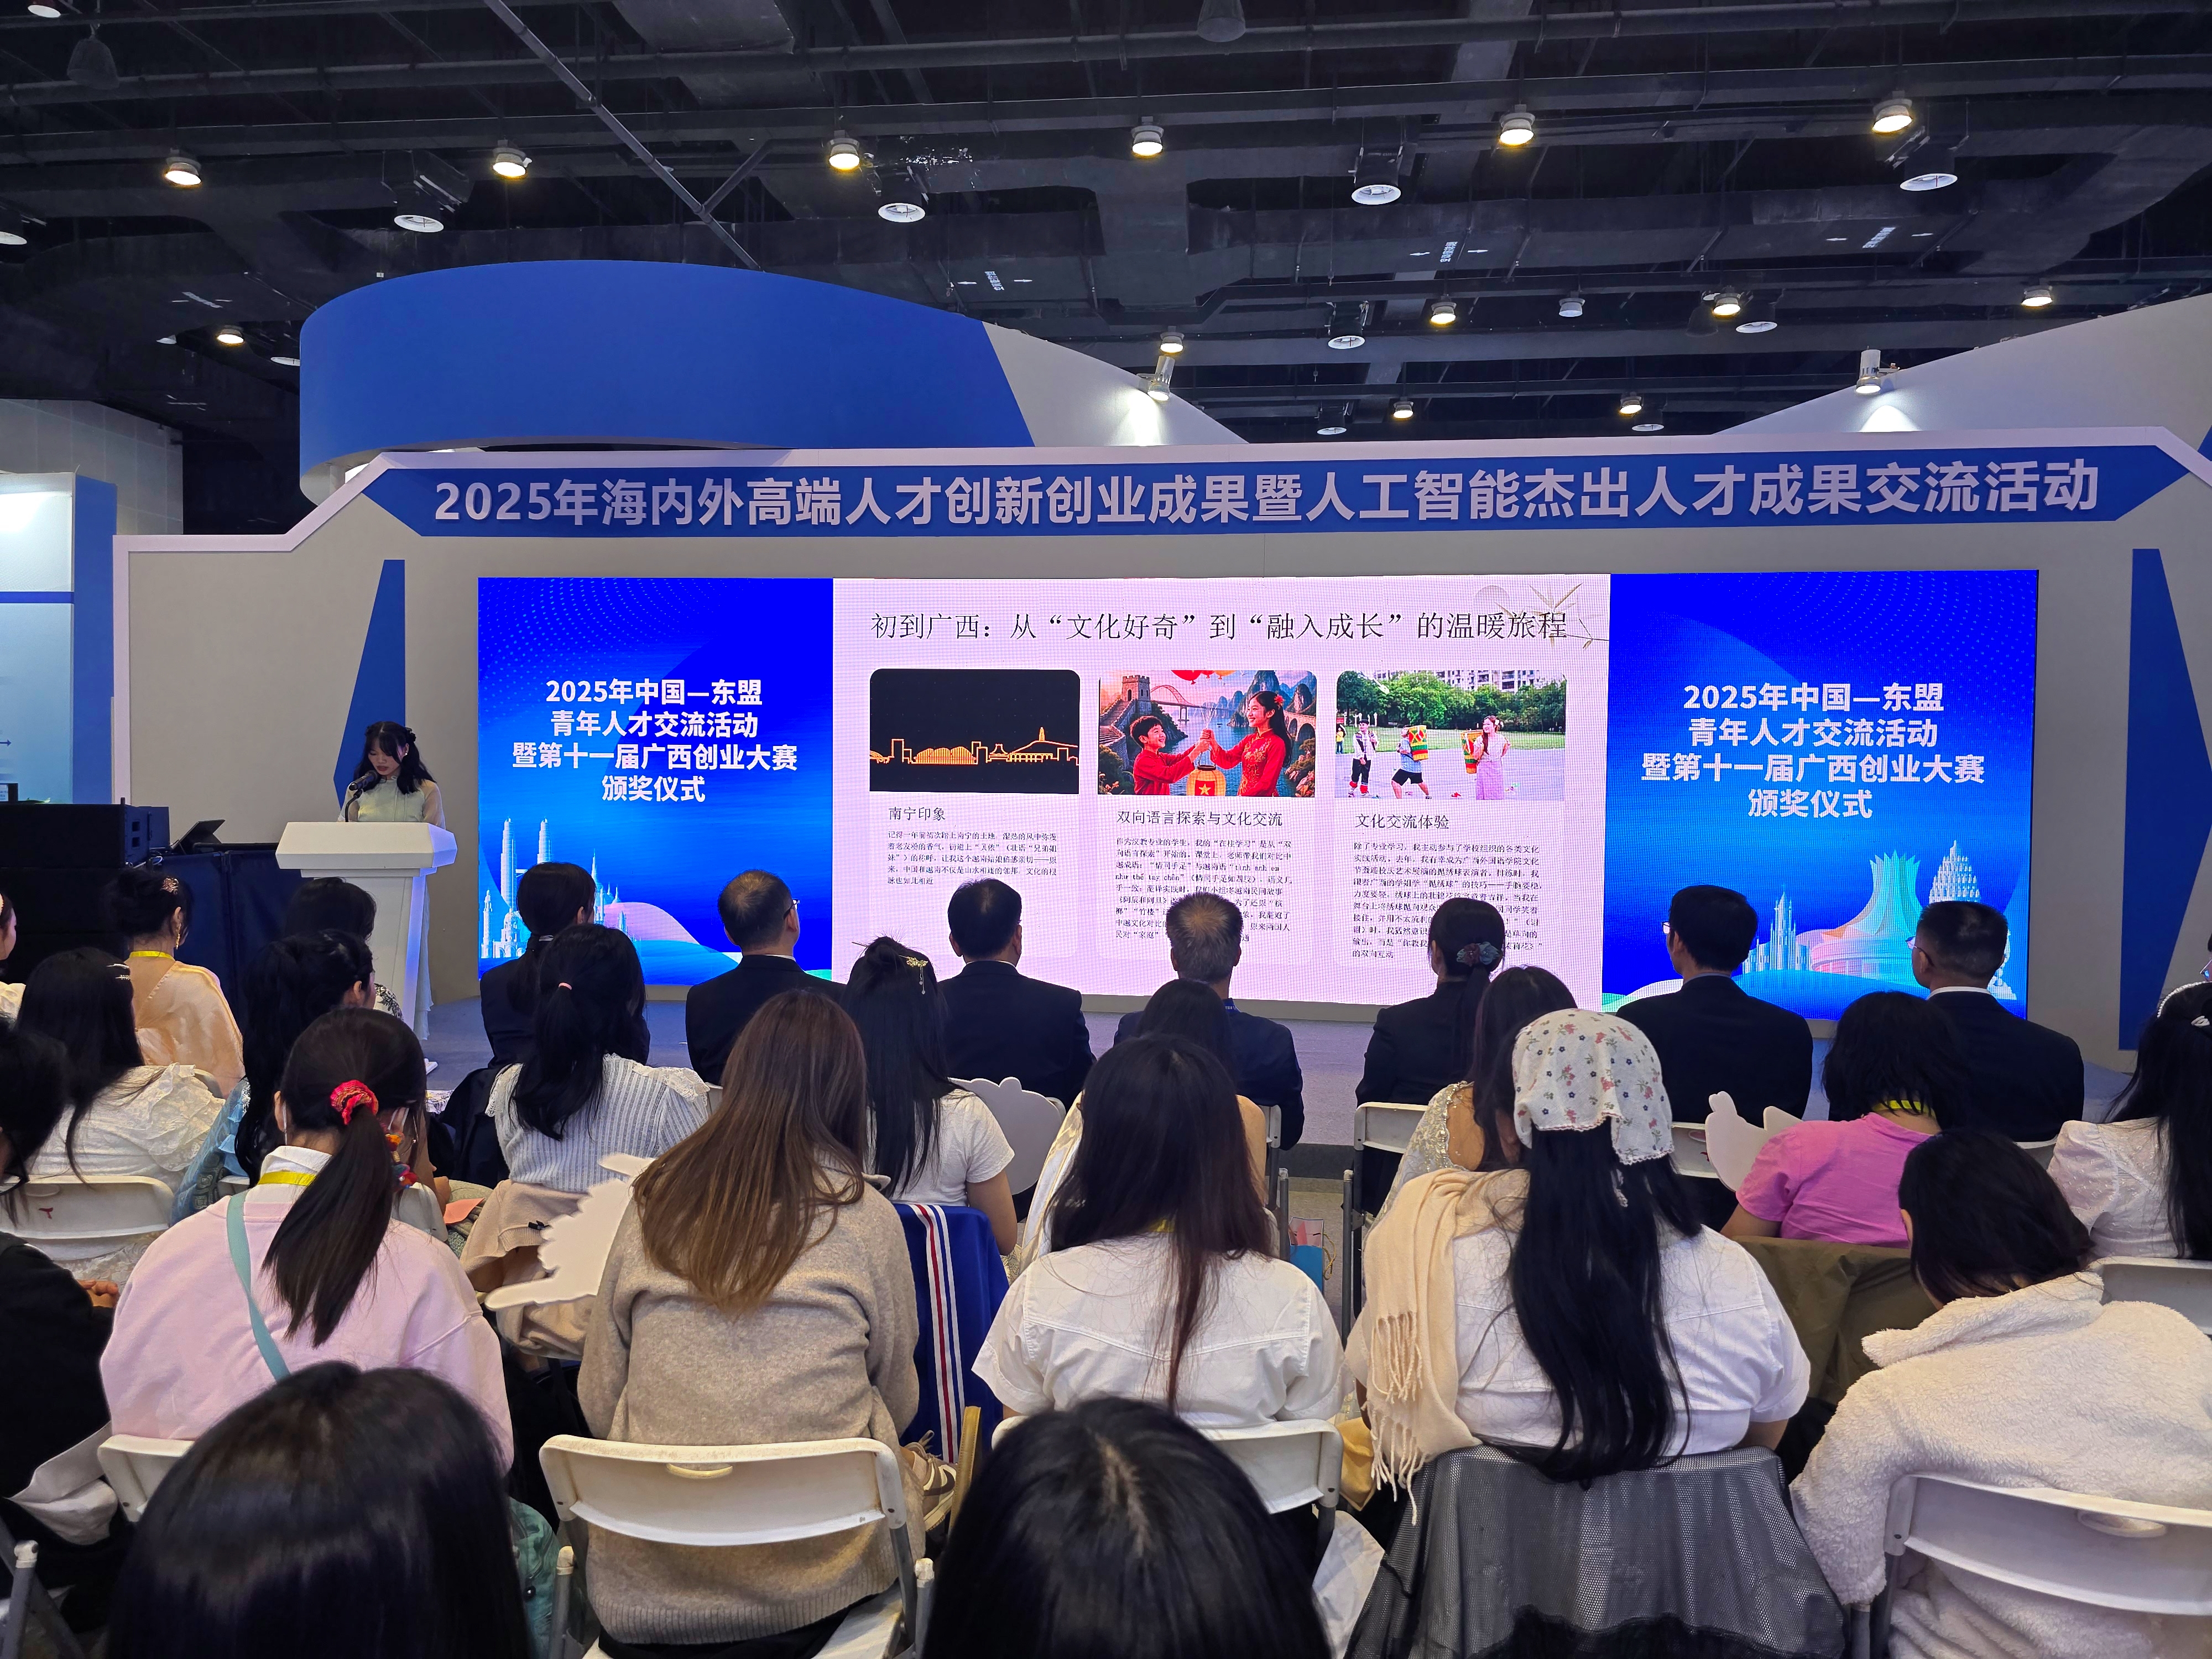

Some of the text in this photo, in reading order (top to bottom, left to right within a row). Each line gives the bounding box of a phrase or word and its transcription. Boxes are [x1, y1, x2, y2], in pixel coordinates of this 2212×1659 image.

[434, 458, 2100, 527] 2025年海内外高端人才创新创业成果暨人工智能杰出人才成果交流活动
[870, 611, 1567, 640] 初到广西：从“文化好奇”到“融入成长”的温暖旅程
[545, 678, 763, 706] 2025年中国—东盟
[1683, 682, 1944, 712] 2025年中国—东盟
[550, 709, 759, 738] 青年人才交流活动
[1688, 717, 1938, 748] 青年人才交流活动
[512, 741, 798, 771] 暨第十一届广西创业大赛
[1641, 753, 1985, 784] 暨第十一届广西创业大赛
[601, 775, 706, 803] 颁奖仪式
[889, 806, 946, 821] 南宁印象
[1117, 810, 1283, 826] 双向语言探索与文化交流
[1747, 789, 1873, 819] 颁奖仪式
[1355, 813, 1449, 830] 文化交流体验
